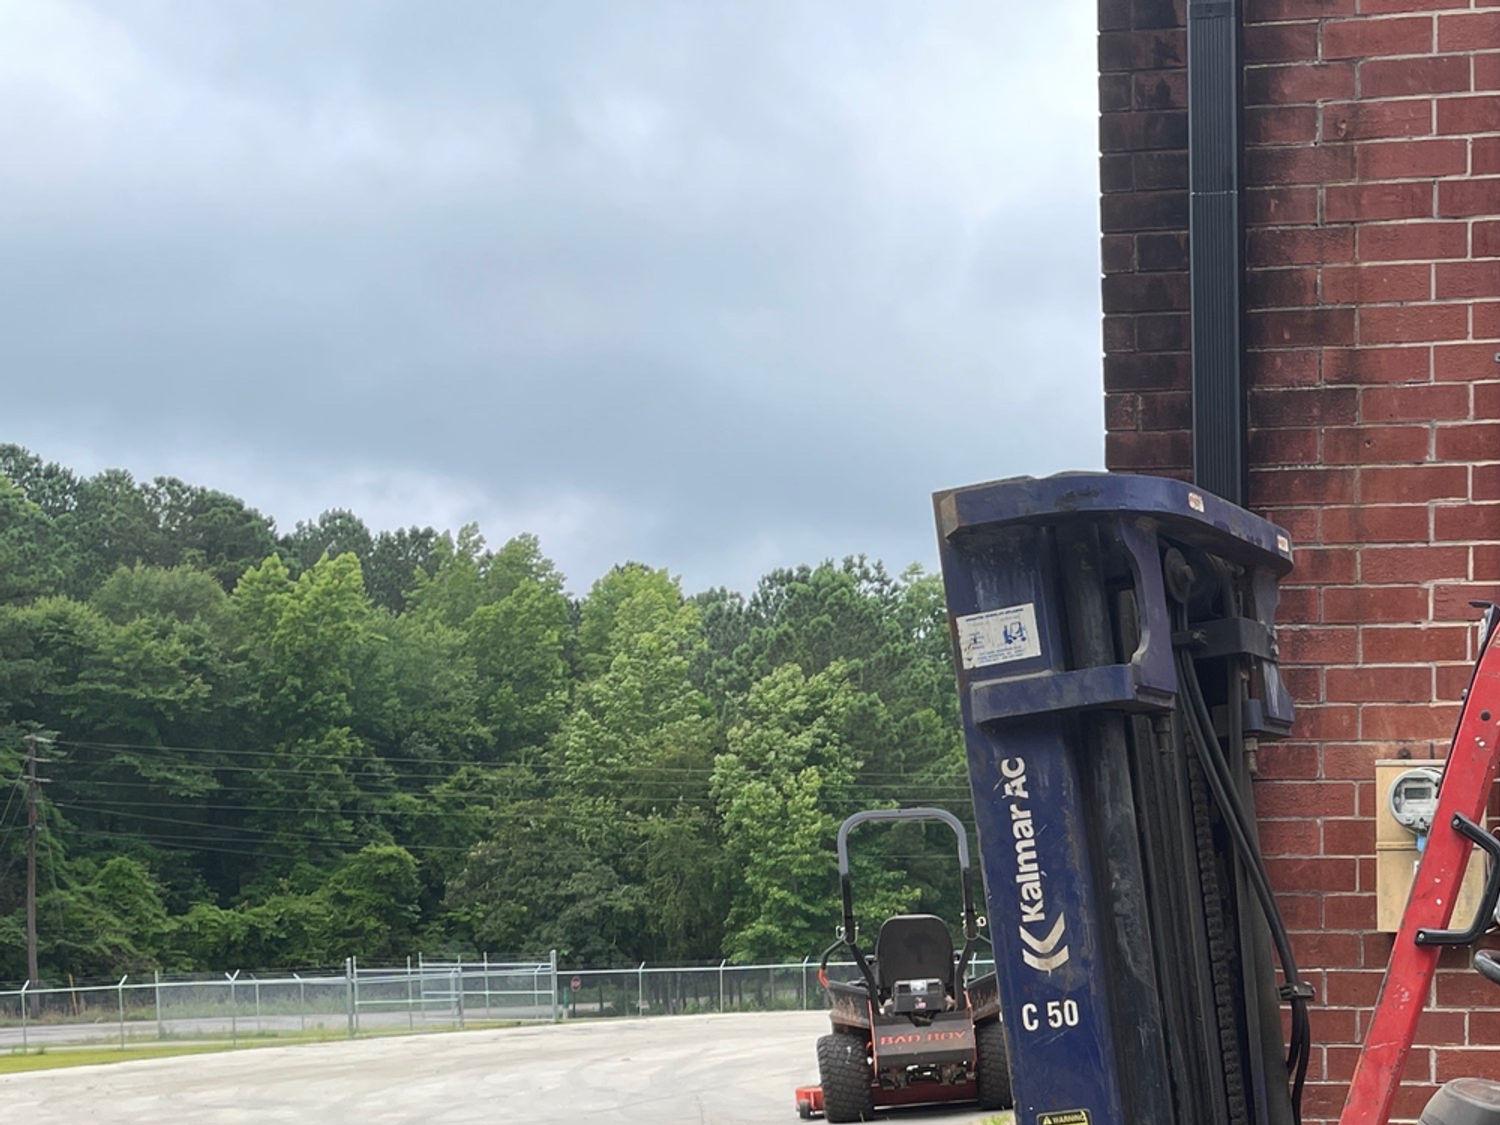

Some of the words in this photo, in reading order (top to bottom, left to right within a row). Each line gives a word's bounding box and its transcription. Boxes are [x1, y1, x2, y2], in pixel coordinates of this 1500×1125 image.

[1002, 756, 1029, 799] AC
[1010, 803, 1046, 923] Kalmar
[1021, 1003, 1040, 1031] C
[1046, 1000, 1079, 1028] 50
[880, 1034, 921, 1046] BAD
[927, 1031, 966, 1041] BOY
